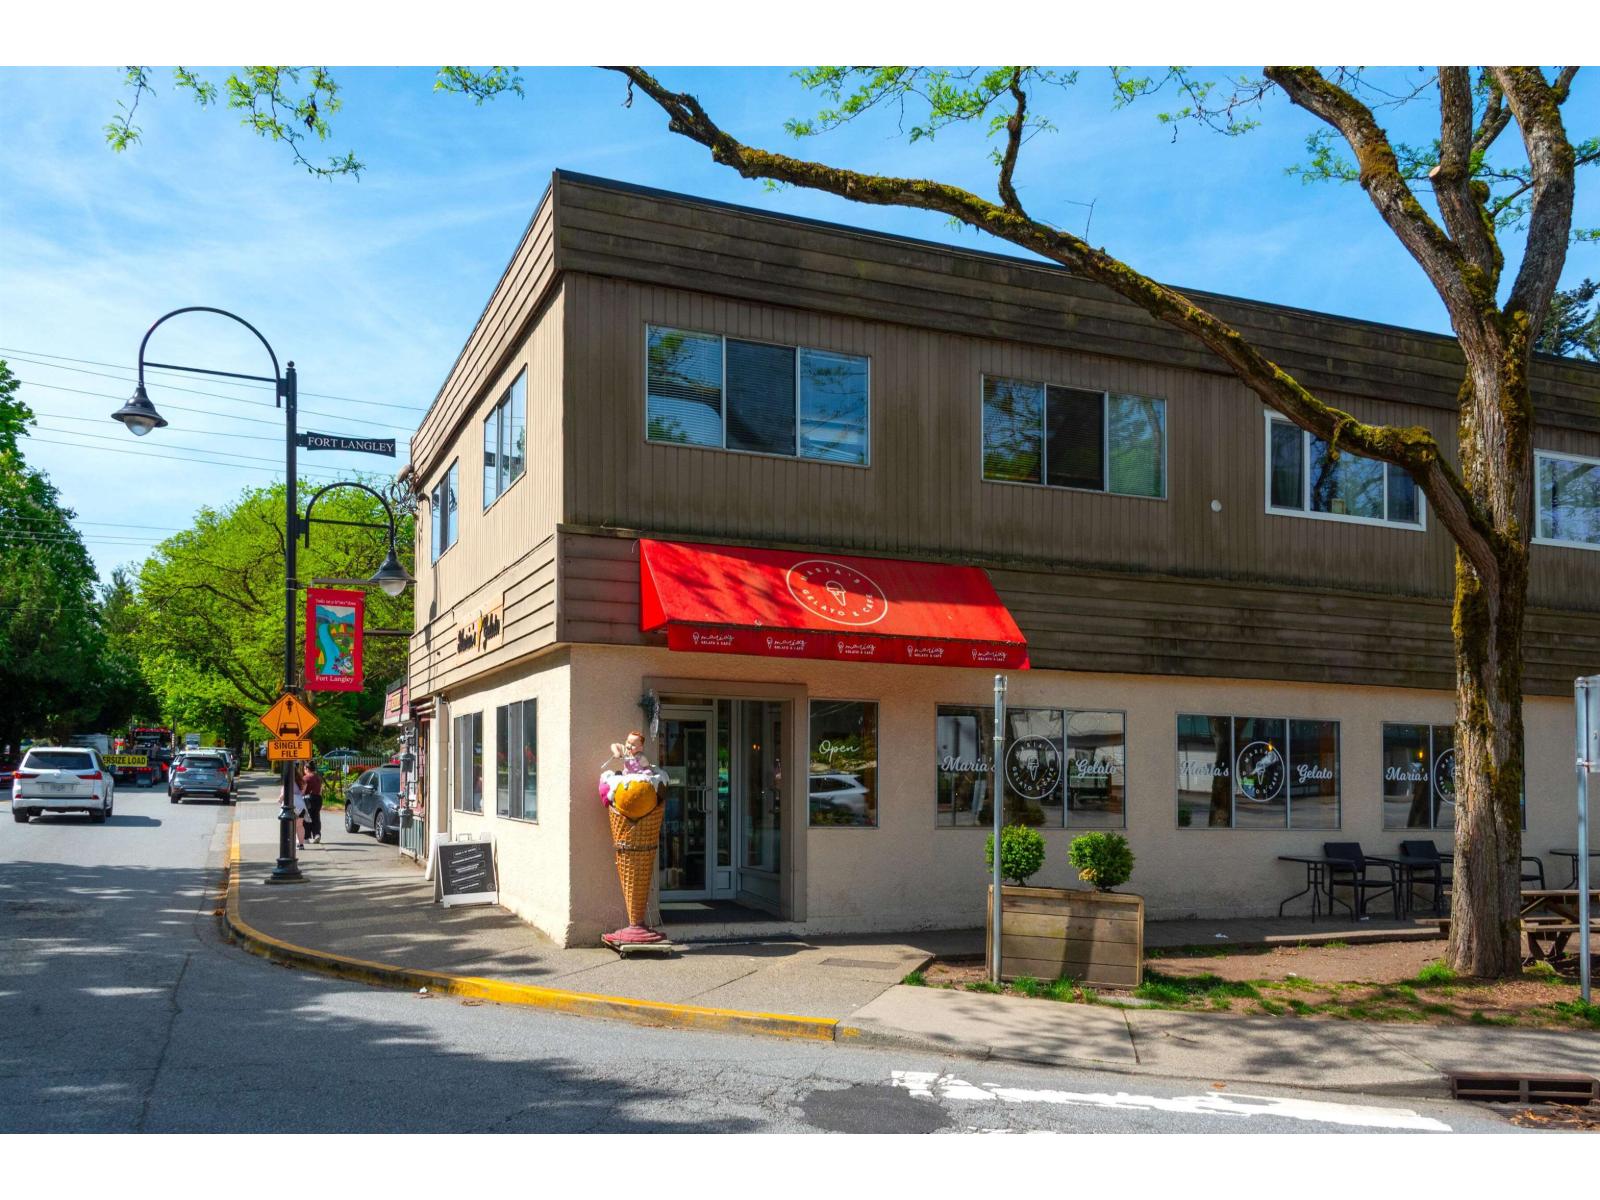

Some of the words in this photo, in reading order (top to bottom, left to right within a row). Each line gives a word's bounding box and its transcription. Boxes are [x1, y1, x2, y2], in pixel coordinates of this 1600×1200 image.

[308, 436, 338, 448] FORT
[341, 439, 395, 453] LANGLEY
[330, 675, 353, 684] Langley
[274, 741, 303, 750] SINGLE
[281, 750, 299, 758] FILE
[819, 740, 860, 762] Open
[102, 756, 126, 765] ERSIZE
[127, 757, 147, 765] LOAD
[941, 755, 996, 772] Maria's
[1075, 758, 1117, 778] Gelato
[1180, 760, 1230, 777] Maria's
[1012, 766, 1032, 791] GELATO
[1296, 764, 1333, 783] Gelato
[1385, 766, 1428, 782] Maria's
